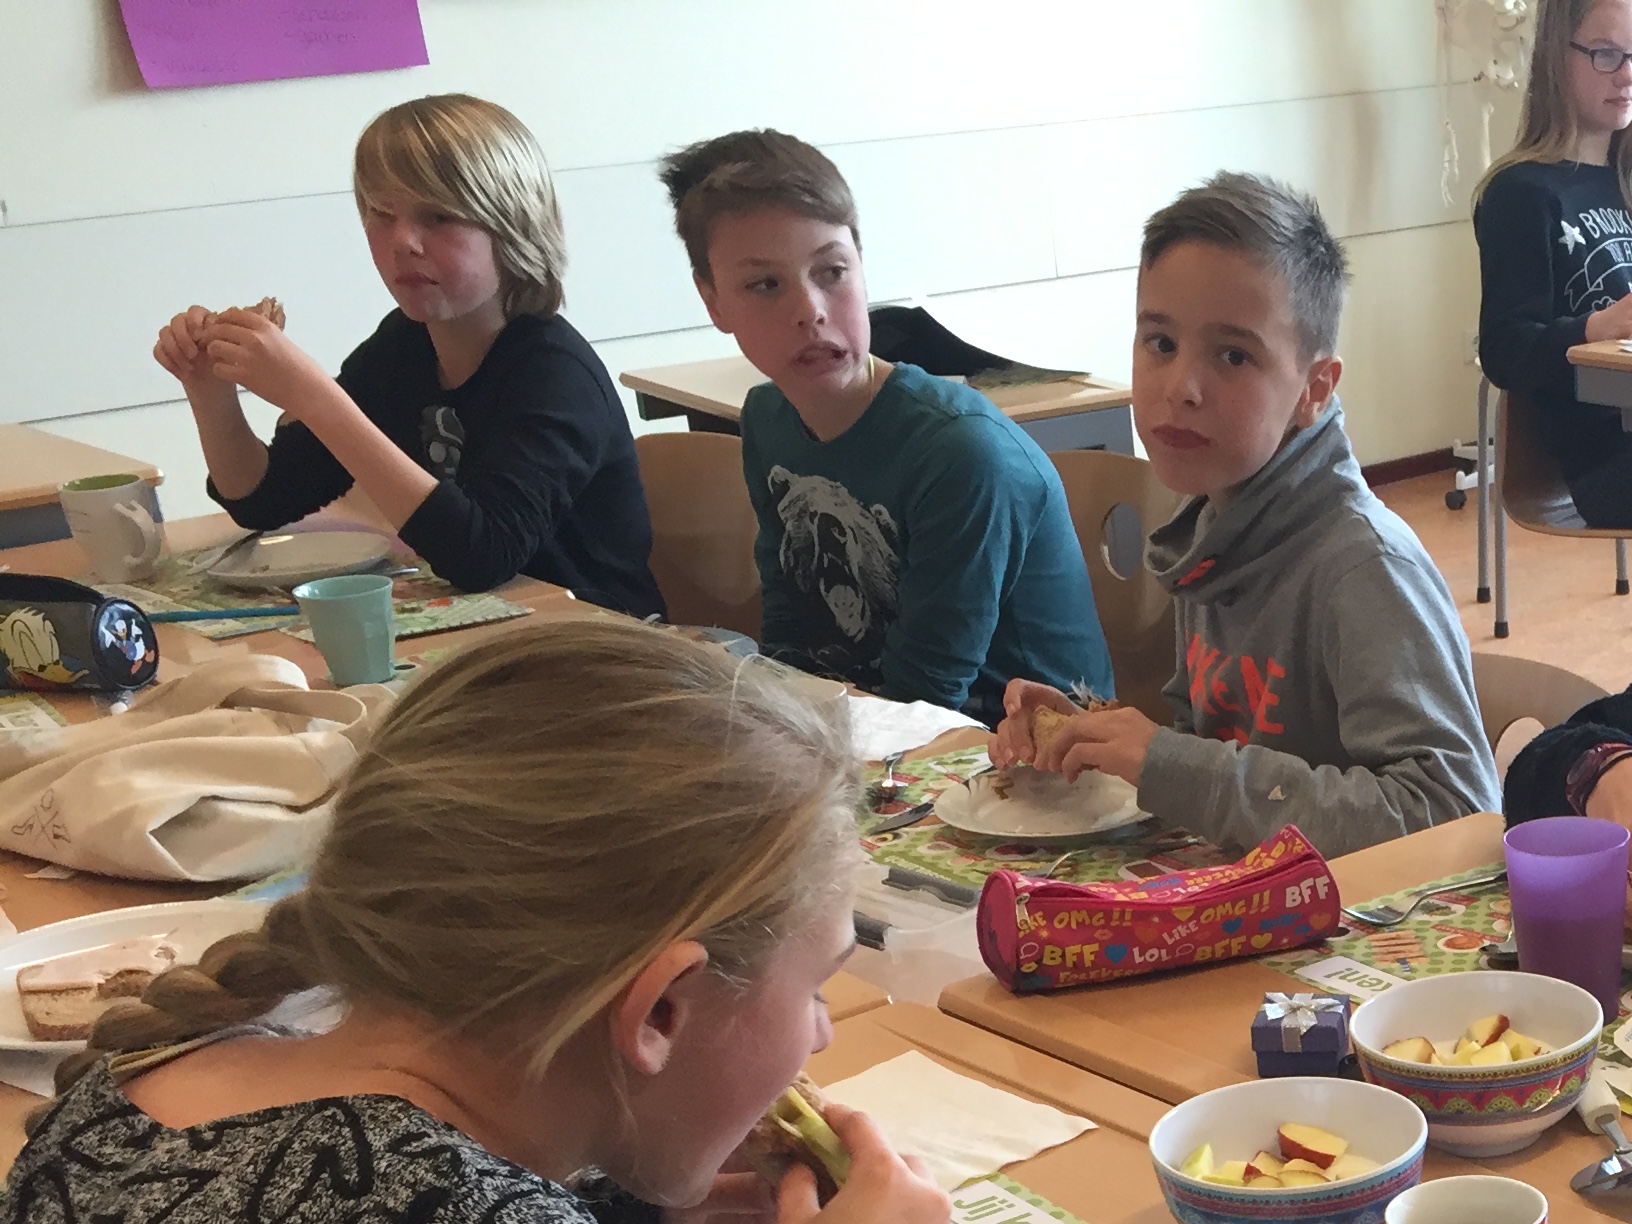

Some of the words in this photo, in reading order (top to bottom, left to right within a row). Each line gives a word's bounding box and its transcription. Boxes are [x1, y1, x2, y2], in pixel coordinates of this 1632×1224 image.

[1285, 874, 1330, 908] BFF
[1162, 919, 1199, 946] LIKE
[1042, 943, 1100, 967] BFF
[1132, 946, 1171, 964] LOL
[1194, 935, 1247, 961] BFF
[953, 1195, 1016, 1222] Jij
